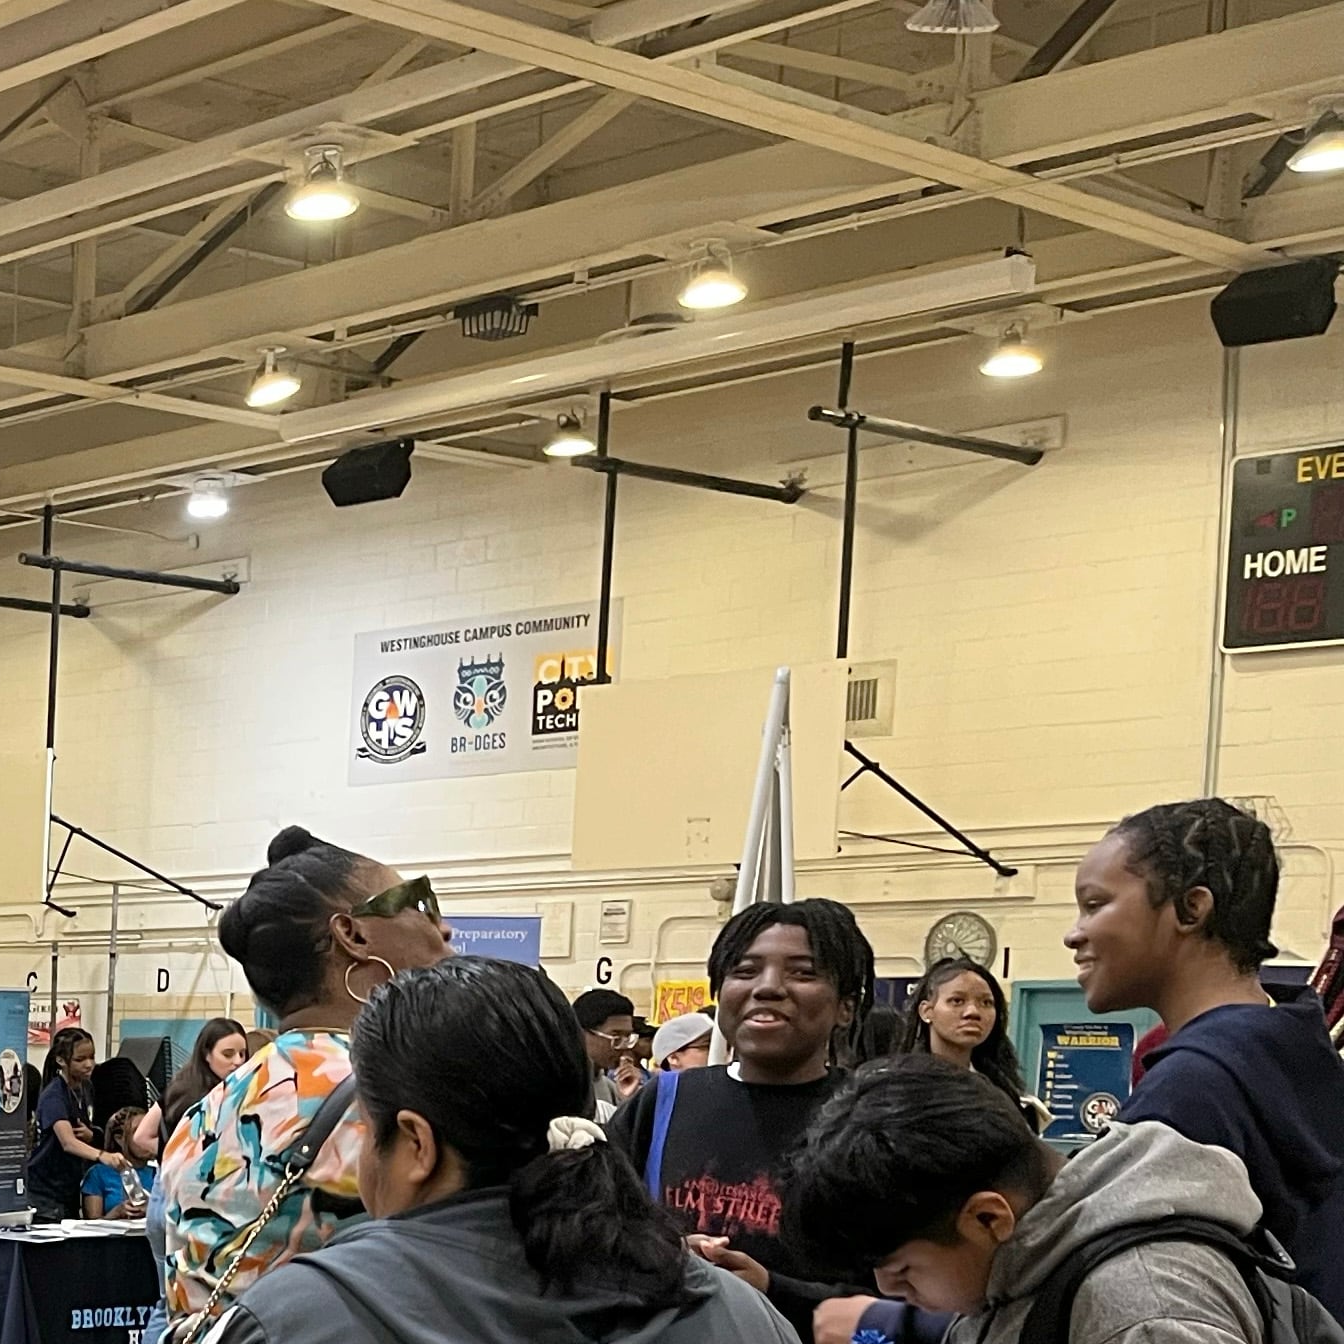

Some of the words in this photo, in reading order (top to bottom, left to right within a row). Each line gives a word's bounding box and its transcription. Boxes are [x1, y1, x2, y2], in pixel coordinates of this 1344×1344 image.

[1296, 452, 1344, 483] EVE
[1281, 508, 1297, 527] P
[1243, 545, 1328, 579] HOME
[380, 631, 460, 653] WESTINGHOUSE
[464, 623, 512, 643] CAMPUS
[515, 613, 591, 636] COMMUNITY
[536, 688, 580, 714] PO
[537, 713, 577, 730] TECH
[451, 927, 528, 942] Preparatory
[26, 971, 38, 993] C
[157, 967, 170, 992] D
[596, 956, 612, 984] G
[1056, 1034, 1120, 1047] WARRIOR
[712, 1197, 782, 1224] STREE
